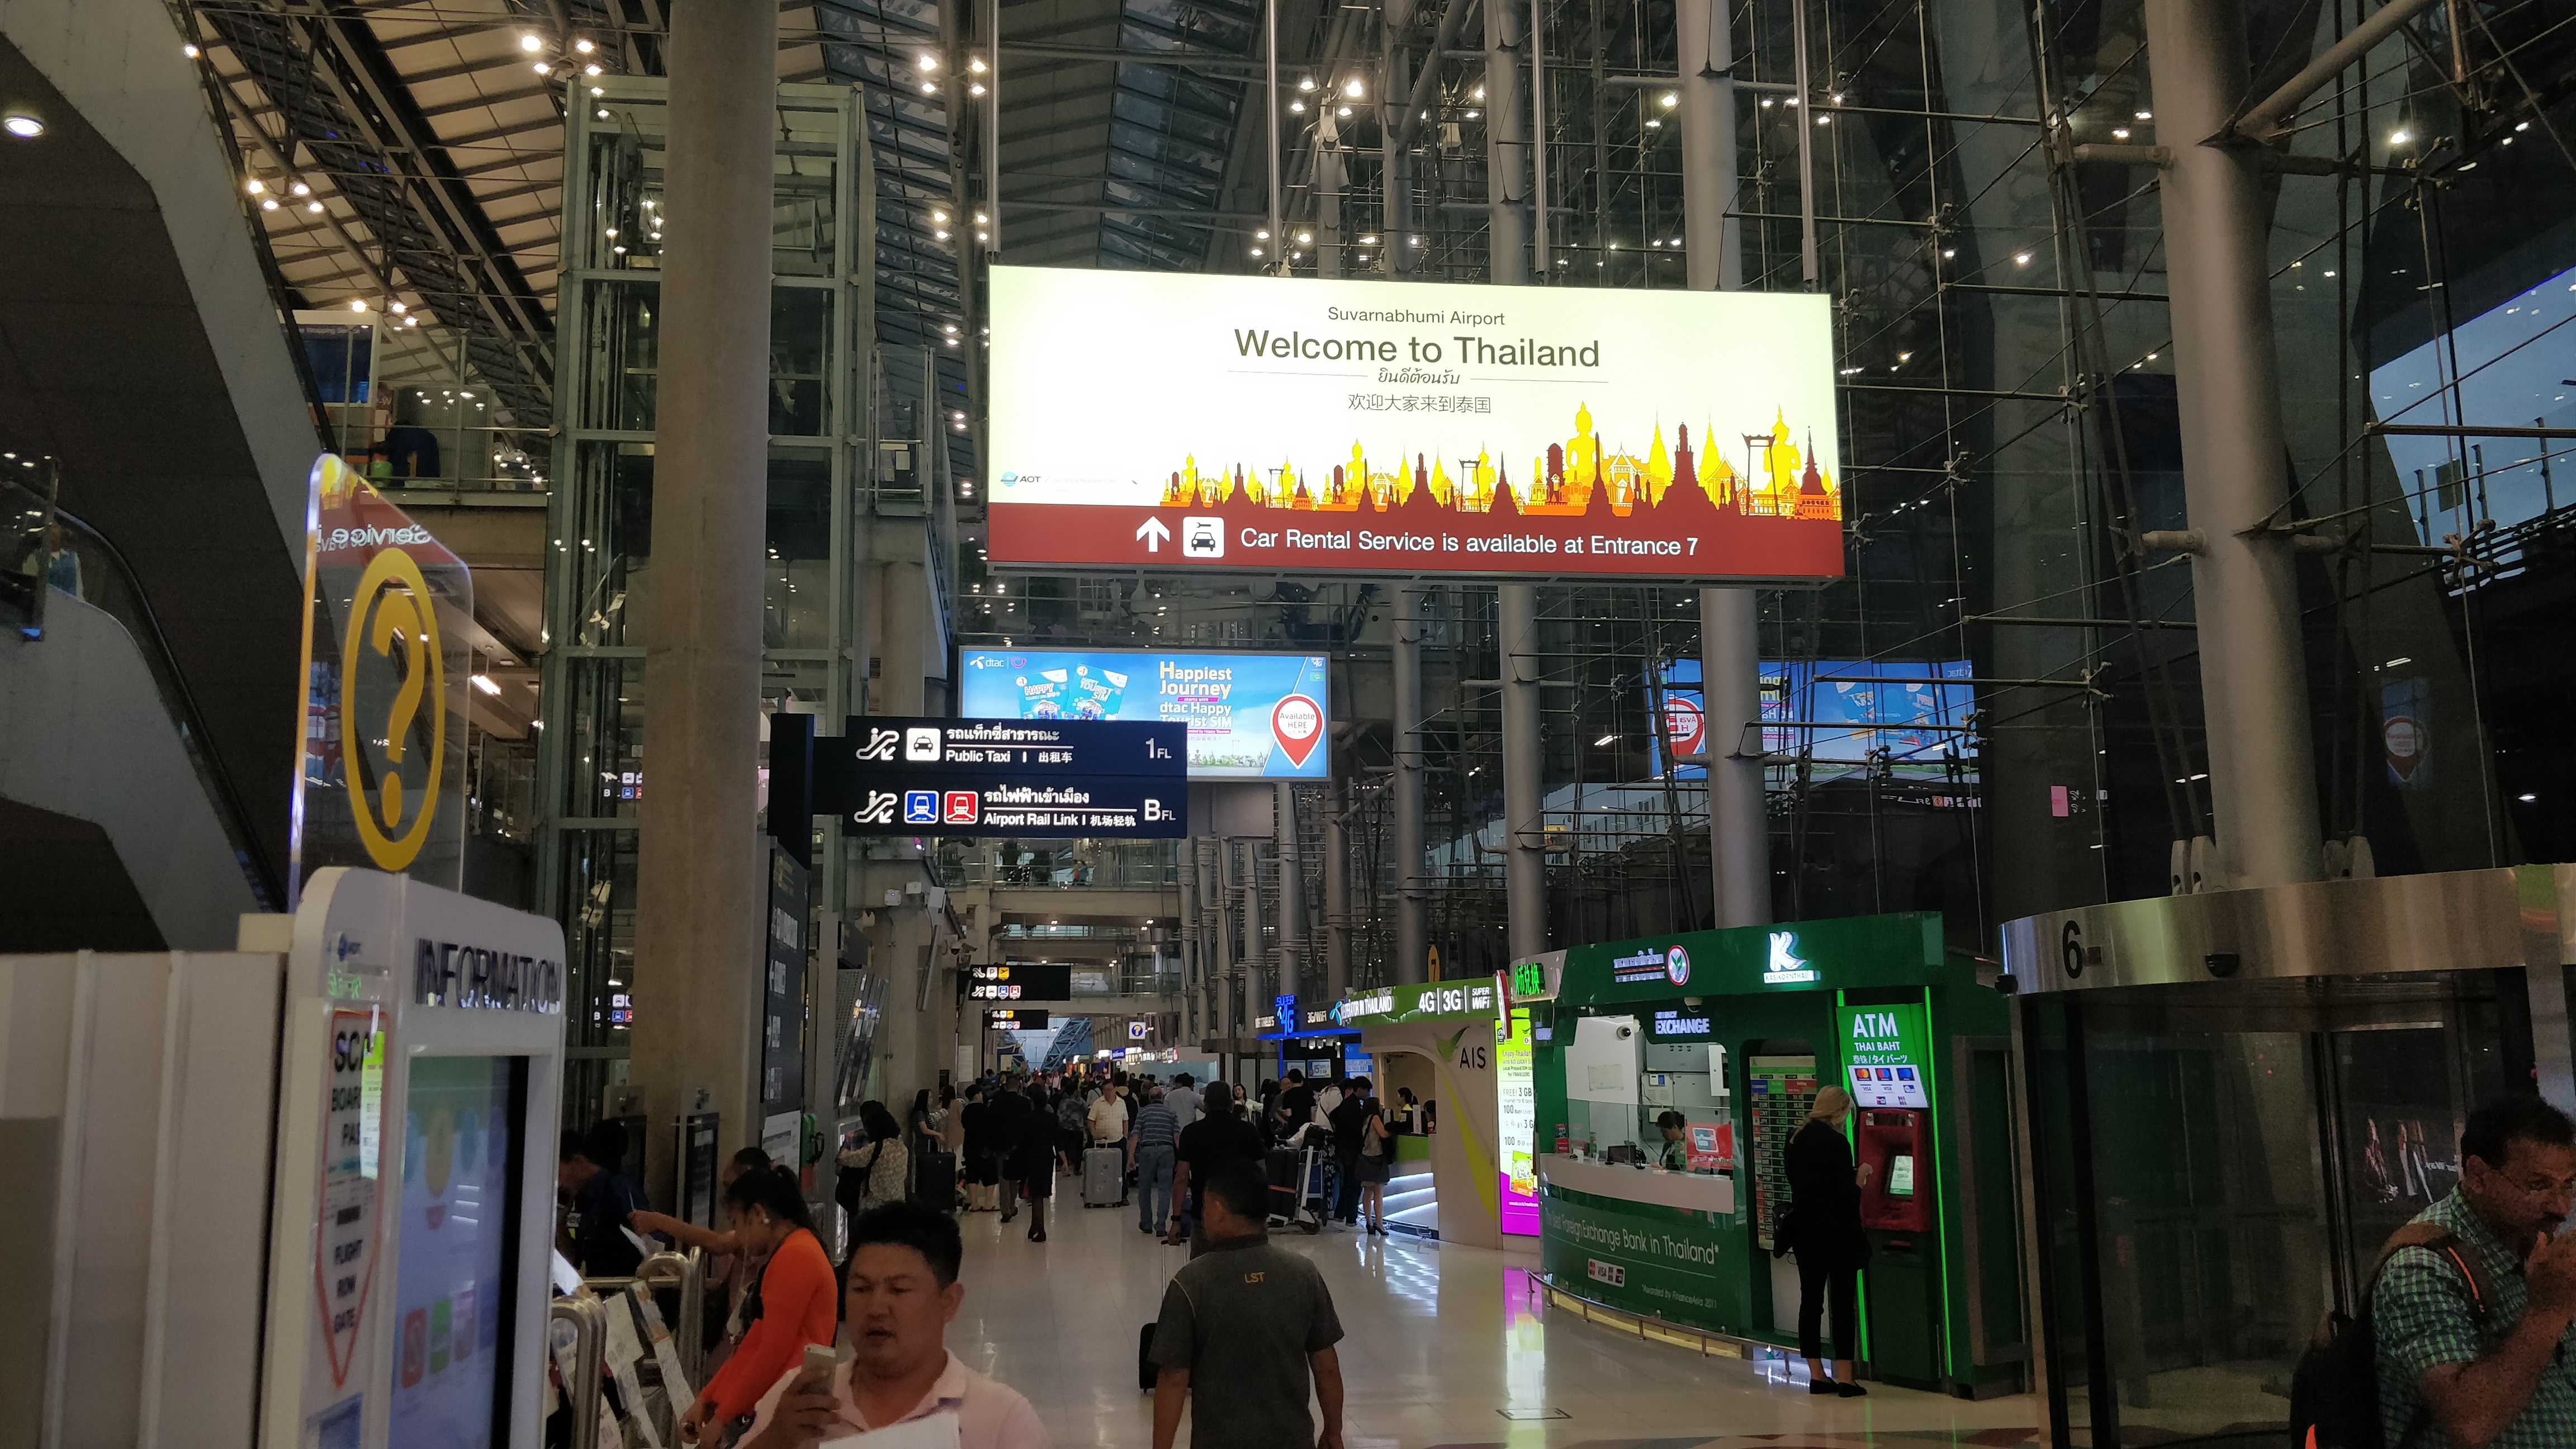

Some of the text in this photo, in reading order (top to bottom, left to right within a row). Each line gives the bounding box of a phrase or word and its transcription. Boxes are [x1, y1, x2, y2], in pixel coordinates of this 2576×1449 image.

[1328, 307, 1505, 327] Suvarnabhumi Airport
[1234, 329, 1599, 367] Welcome to Thailand
[1378, 367, 1460, 385] ยินดีต้อนรับ
[1348, 394, 1491, 414] 欢迎大家来到泰国
[1240, 528, 1698, 556] Car Rental Service is available at Entrance 7
[986, 657, 1005, 667] dtac
[1159, 660, 1232, 683] Happiest
[1025, 683, 1054, 696] HAPPY
[1092, 691, 1110, 702] SIM
[1159, 680, 1232, 699] Journey
[1159, 701, 1232, 717] dtac Happy
[1210, 716, 1232, 728] SIM
[1280, 712, 1315, 721] Available
[946, 722, 1060, 741] รถแท็กซี่สาธารณะ
[946, 750, 1011, 763] Public Taxi
[1039, 751, 1073, 764] 出租车
[984, 784, 1090, 804] รถไฟฟ้าเข้าเมือง
[984, 813, 1078, 827] Airport Rail Link
[1090, 815, 1136, 826] 机场轻轨
[2062, 920, 2083, 979] 6
[415, 937, 561, 1015] INFORMATION
[1471, 987, 1490, 996] SUPER
[1276, 994, 1294, 1006] SUPER
[1365, 996, 1392, 1015] THAILAND
[1419, 989, 1461, 1012] 4G 3G
[1471, 997, 1490, 1010] WiFi
[1655, 1018, 1711, 1035] EXCHANGE
[1853, 1012, 1899, 1038] ATM
[1854, 1041, 1901, 1052] THAI BAHT
[1460, 1046, 1486, 1069] AIS
[1502, 1050, 1514, 1058] Enjoy
[1503, 1087, 1532, 1097] FREE! 3 GB
[1503, 1105, 1514, 1114] 100
[1524, 1119, 1528, 1129] 3
[1529, 1119, 1533, 1129] G
[1504, 1137, 1515, 1145] 100
[1582, 1220, 1621, 1252] Exchange
[1622, 1228, 1648, 1253] Bank
[1650, 1235, 1660, 1254] in
[1244, 1272, 1265, 1284] LST
